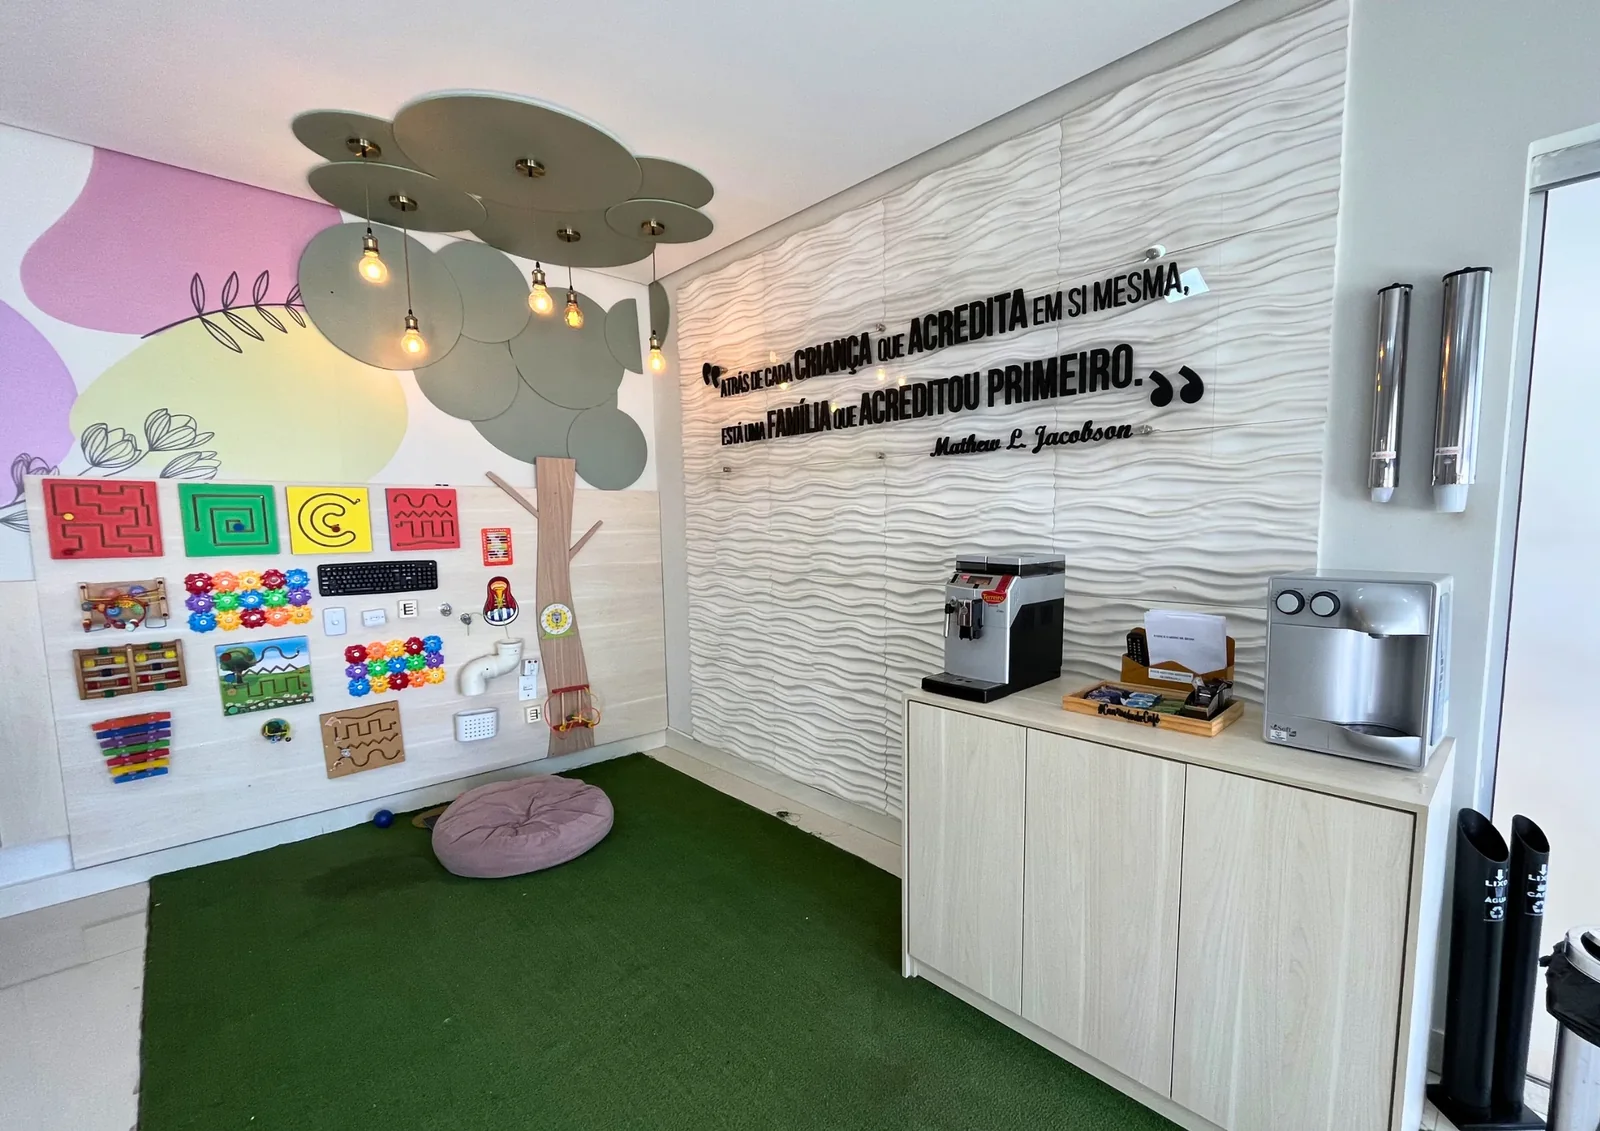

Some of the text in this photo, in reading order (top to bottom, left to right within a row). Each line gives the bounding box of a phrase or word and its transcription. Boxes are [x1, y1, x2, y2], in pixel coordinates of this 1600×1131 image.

[751, 370, 764, 390] DE
[764, 362, 793, 387] CADA
[794, 332, 872, 374] CRIANÇA
[877, 333, 905, 361] QUE
[908, 288, 1028, 354] ACREDITA
[1033, 291, 1062, 325] EM
[1068, 285, 1087, 317] SI
[1093, 262, 1190, 312] MESMA,
[721, 422, 743, 446] ESTÁ
[744, 421, 766, 442] UMA
[767, 398, 832, 438] FAMÍLIA
[833, 405, 858, 429] QUE
[859, 371, 980, 425] ACREDITOU
[930, 433, 1002, 457] Mathew
[1031, 420, 1133, 454] Jacobson
[983, 593, 1005, 601] Terreiro
[1485, 879, 1508, 887] LIXO
